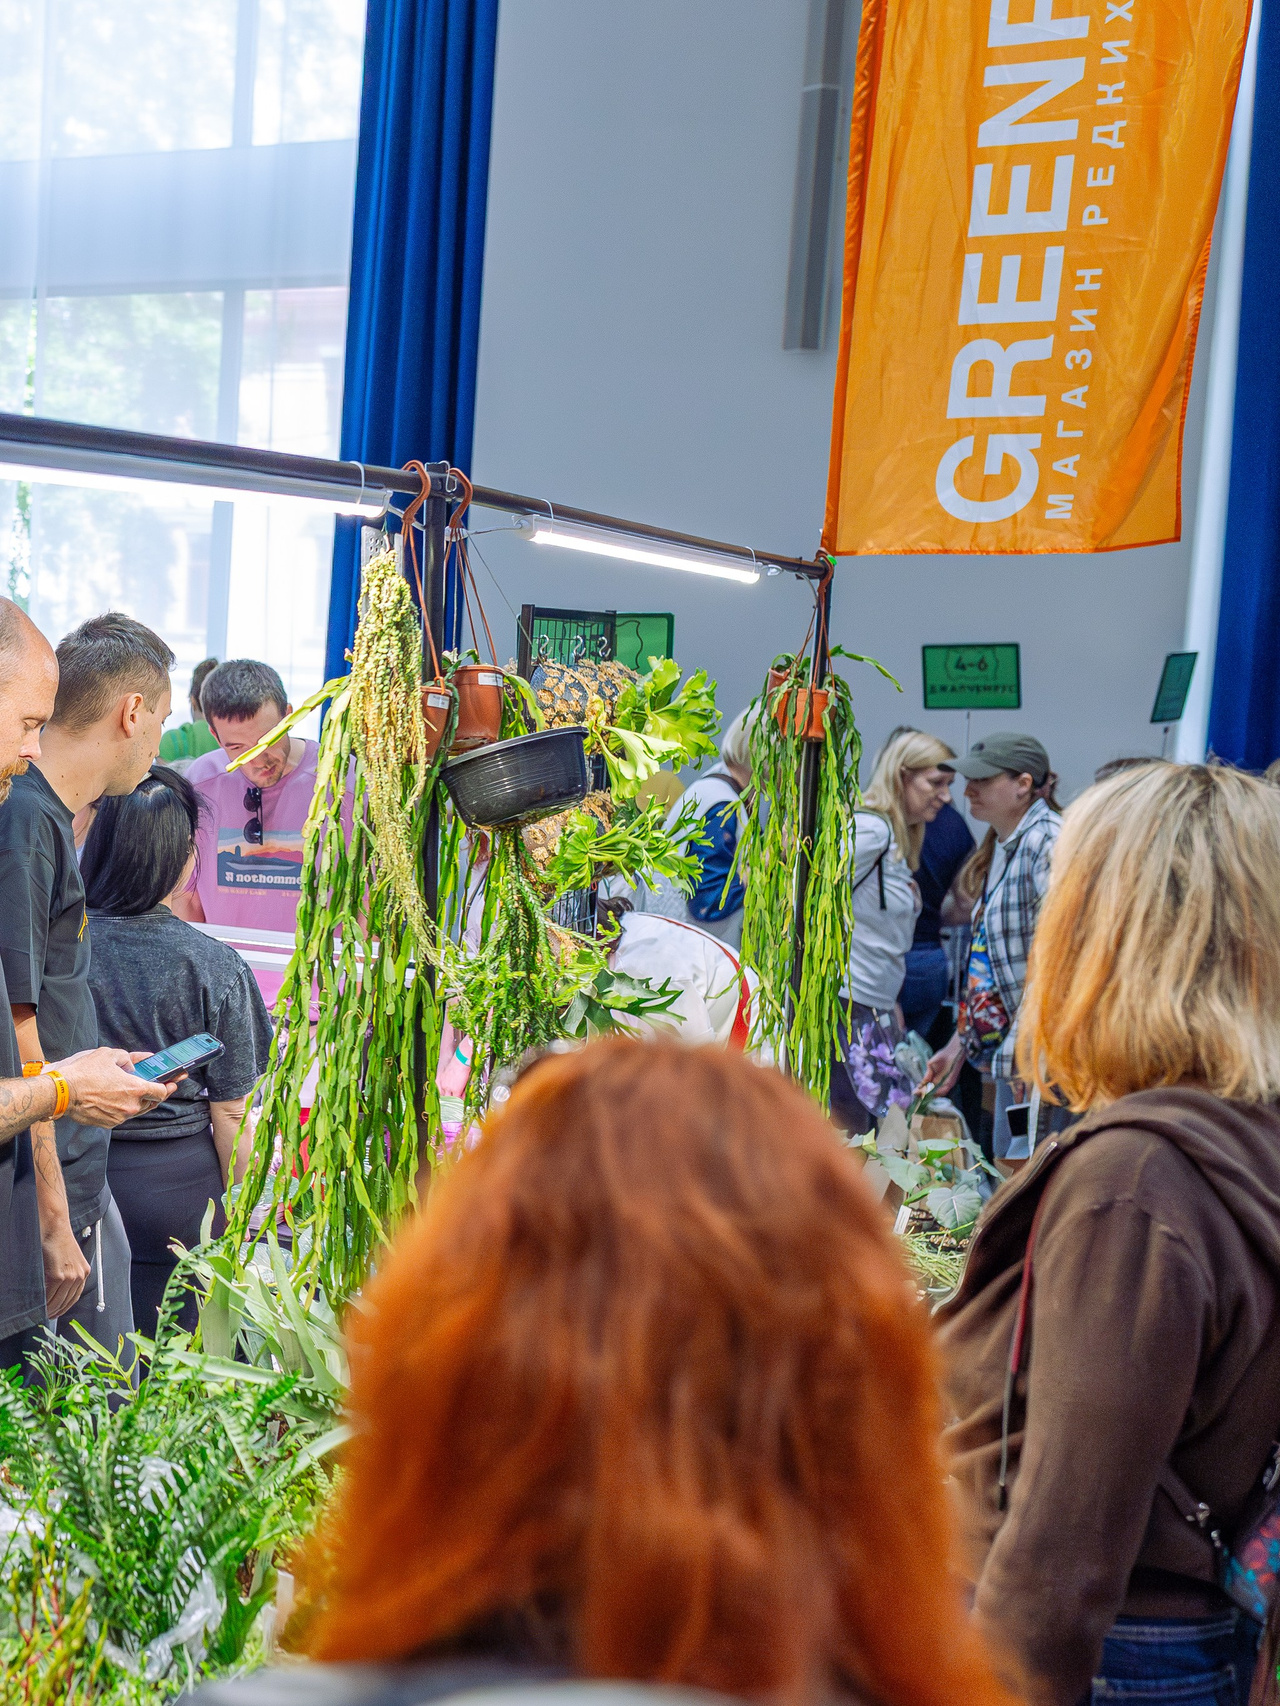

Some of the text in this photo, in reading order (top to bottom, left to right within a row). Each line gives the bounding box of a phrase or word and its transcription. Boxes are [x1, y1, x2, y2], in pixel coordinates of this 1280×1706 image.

[1045, 0, 1134, 520] МАГАЗИН РЕДКИХ
[954, 655, 989, 672] 4-6
